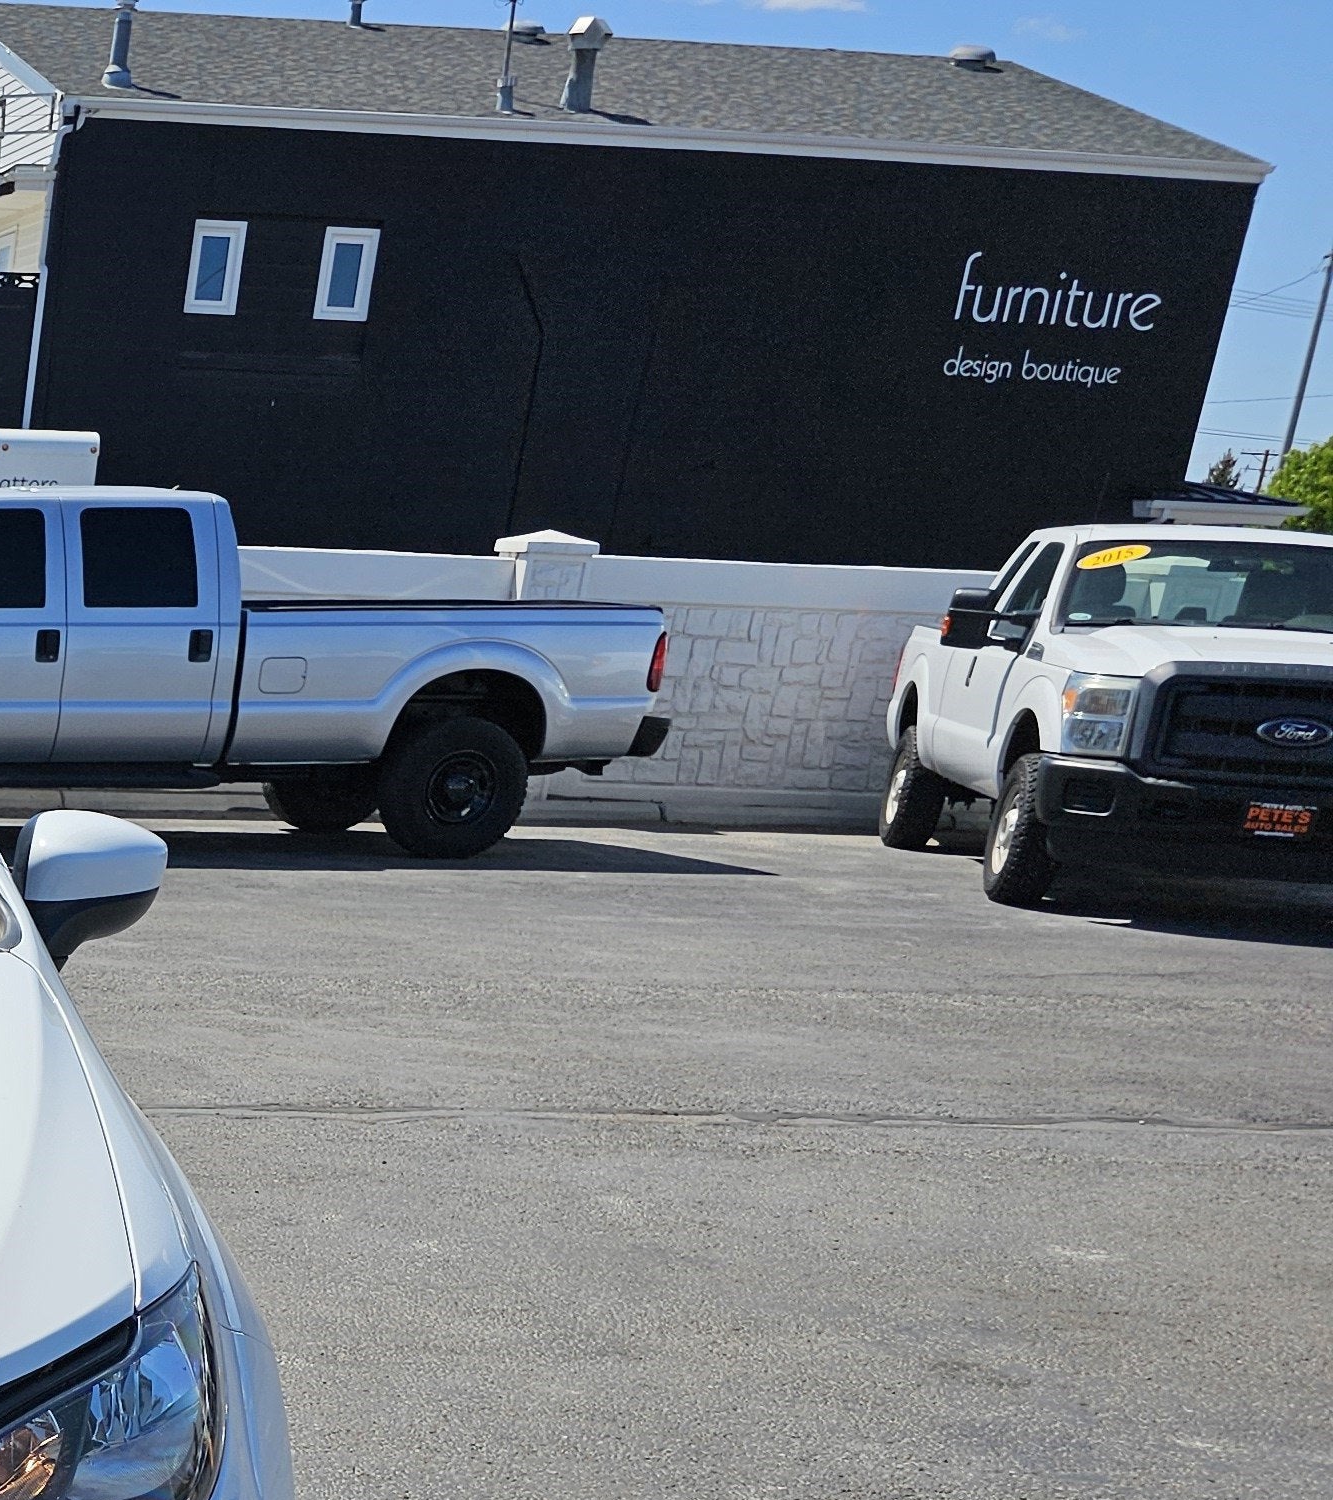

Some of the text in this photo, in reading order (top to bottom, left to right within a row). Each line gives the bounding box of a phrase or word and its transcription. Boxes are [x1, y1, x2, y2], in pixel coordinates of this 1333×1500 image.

[954, 251, 1162, 331] furniture
[943, 345, 1122, 388] design boutique
[1092, 548, 1134, 565] 2015
[1274, 723, 1319, 741] Ford
[1247, 807, 1312, 824] PETE'S
